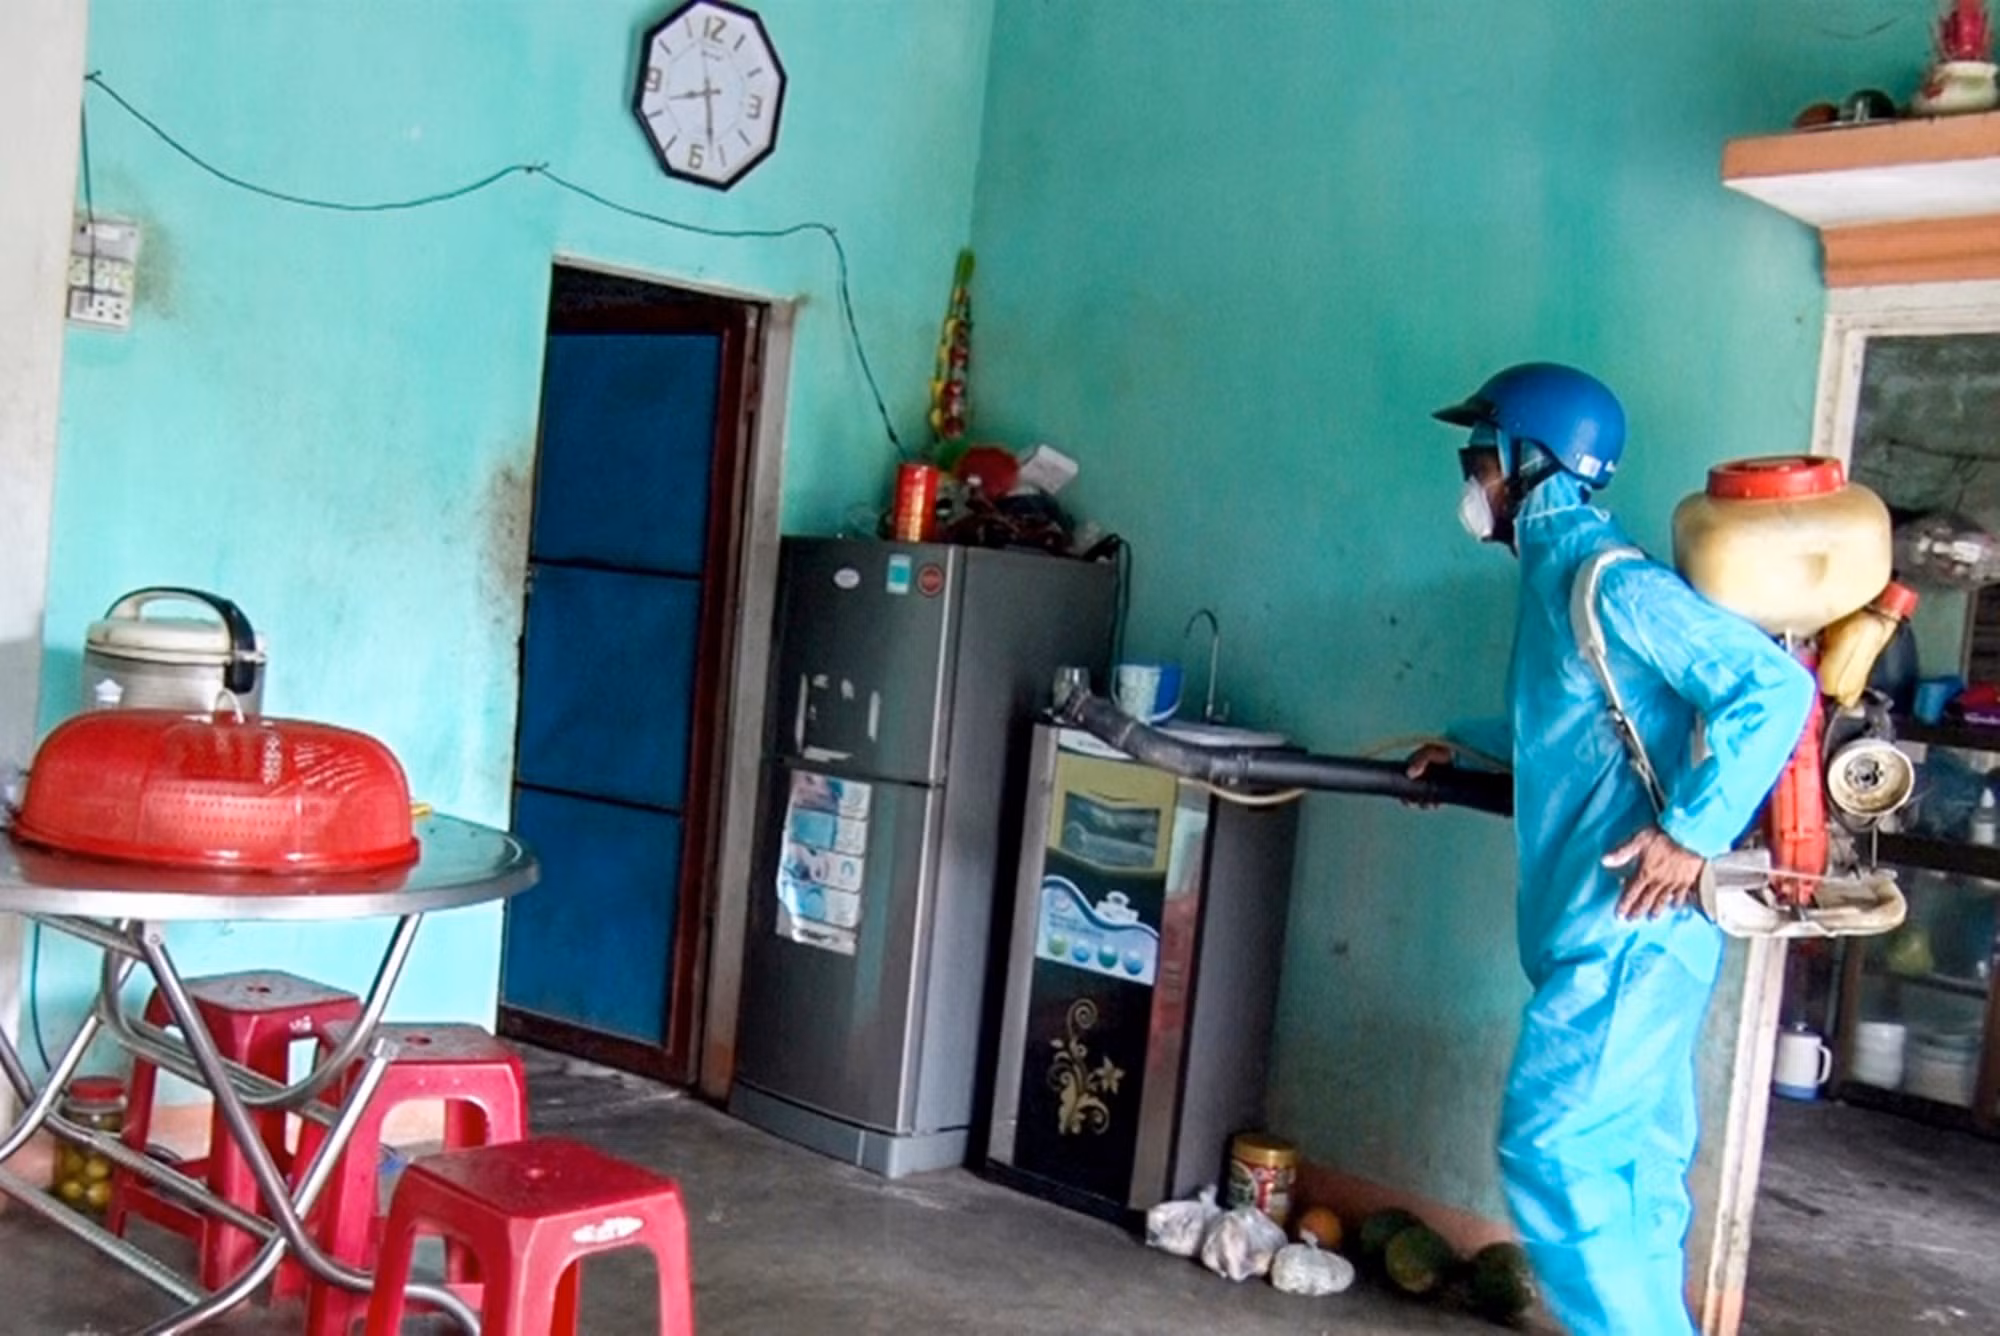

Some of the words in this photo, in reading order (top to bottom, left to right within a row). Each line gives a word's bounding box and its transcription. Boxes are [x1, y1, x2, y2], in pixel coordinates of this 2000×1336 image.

[704, 15, 727, 44] 12
[646, 67, 662, 92] 9
[747, 94, 762, 119] 3
[688, 143, 704, 169] 6
